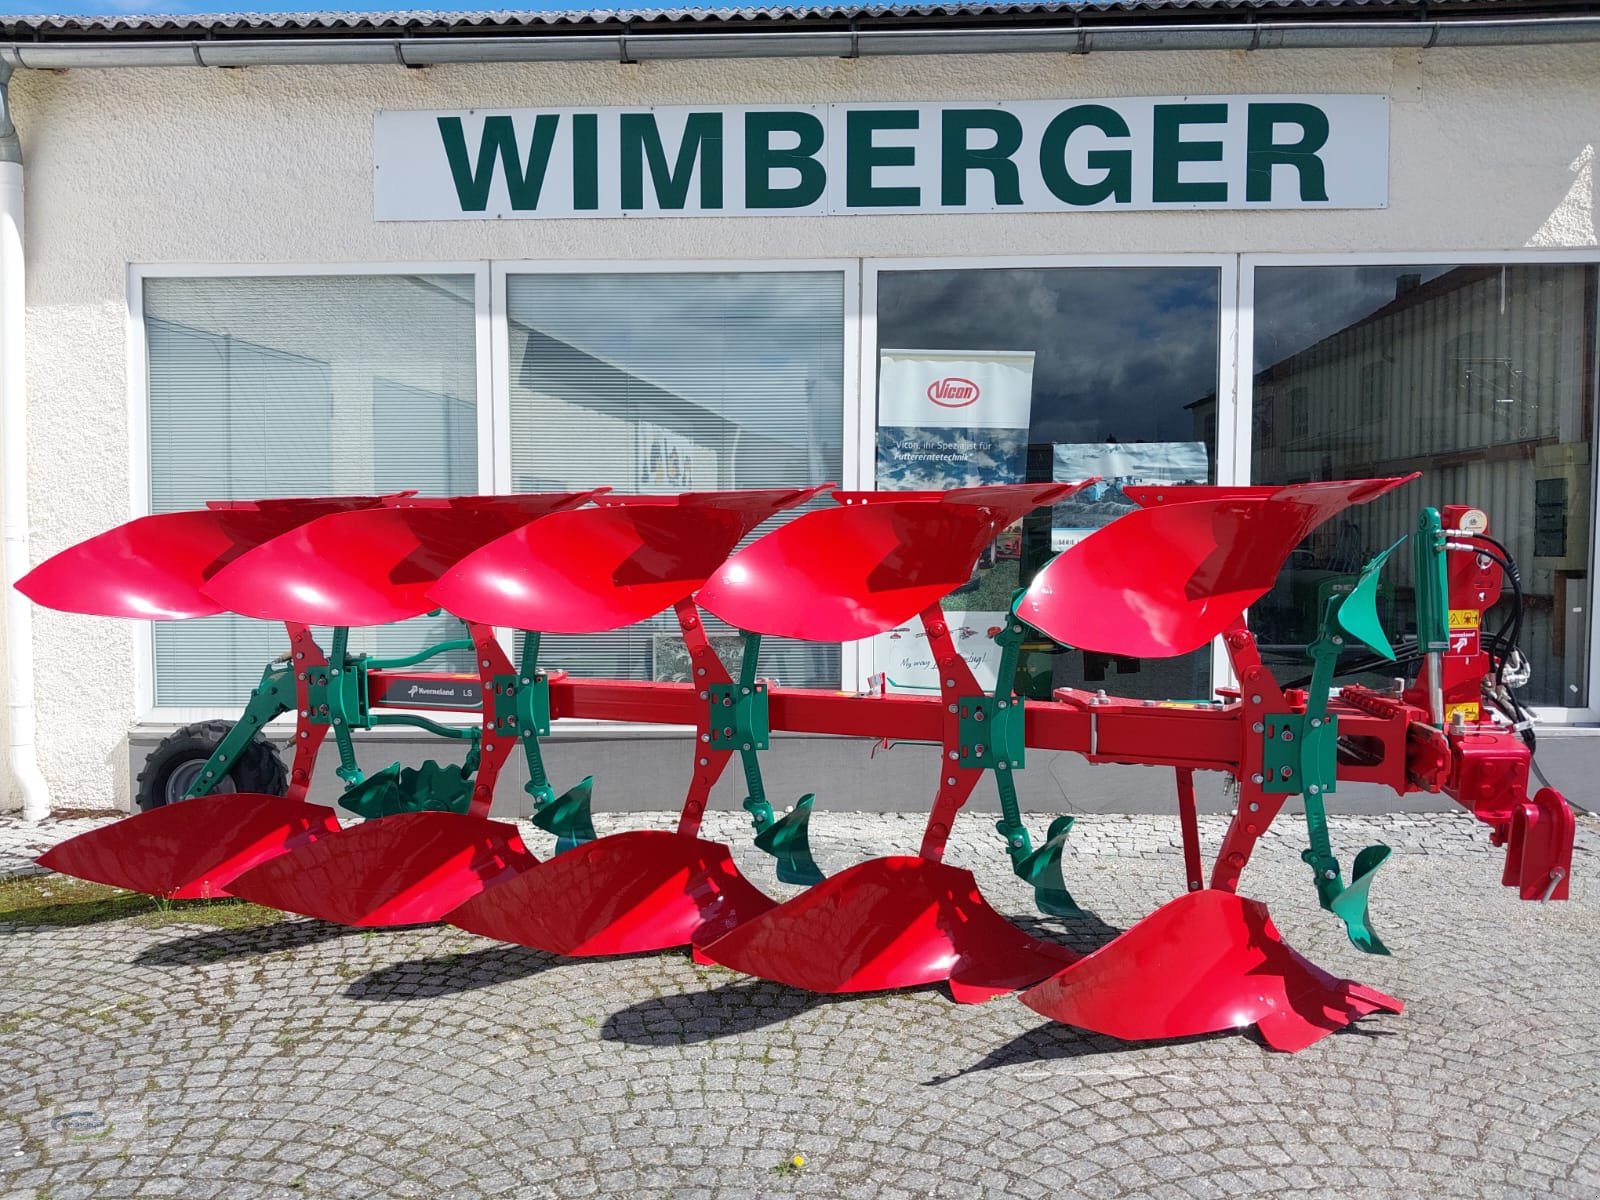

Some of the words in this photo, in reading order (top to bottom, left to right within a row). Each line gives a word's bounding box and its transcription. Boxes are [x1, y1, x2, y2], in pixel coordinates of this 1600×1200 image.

[437, 103, 1330, 210] WIMBERGER
[936, 380, 973, 399] Vicon
[937, 441, 977, 451] Spezialist
[979, 441, 992, 450] für
[418, 687, 455, 696] Kverneland
[463, 689, 473, 697] LS
